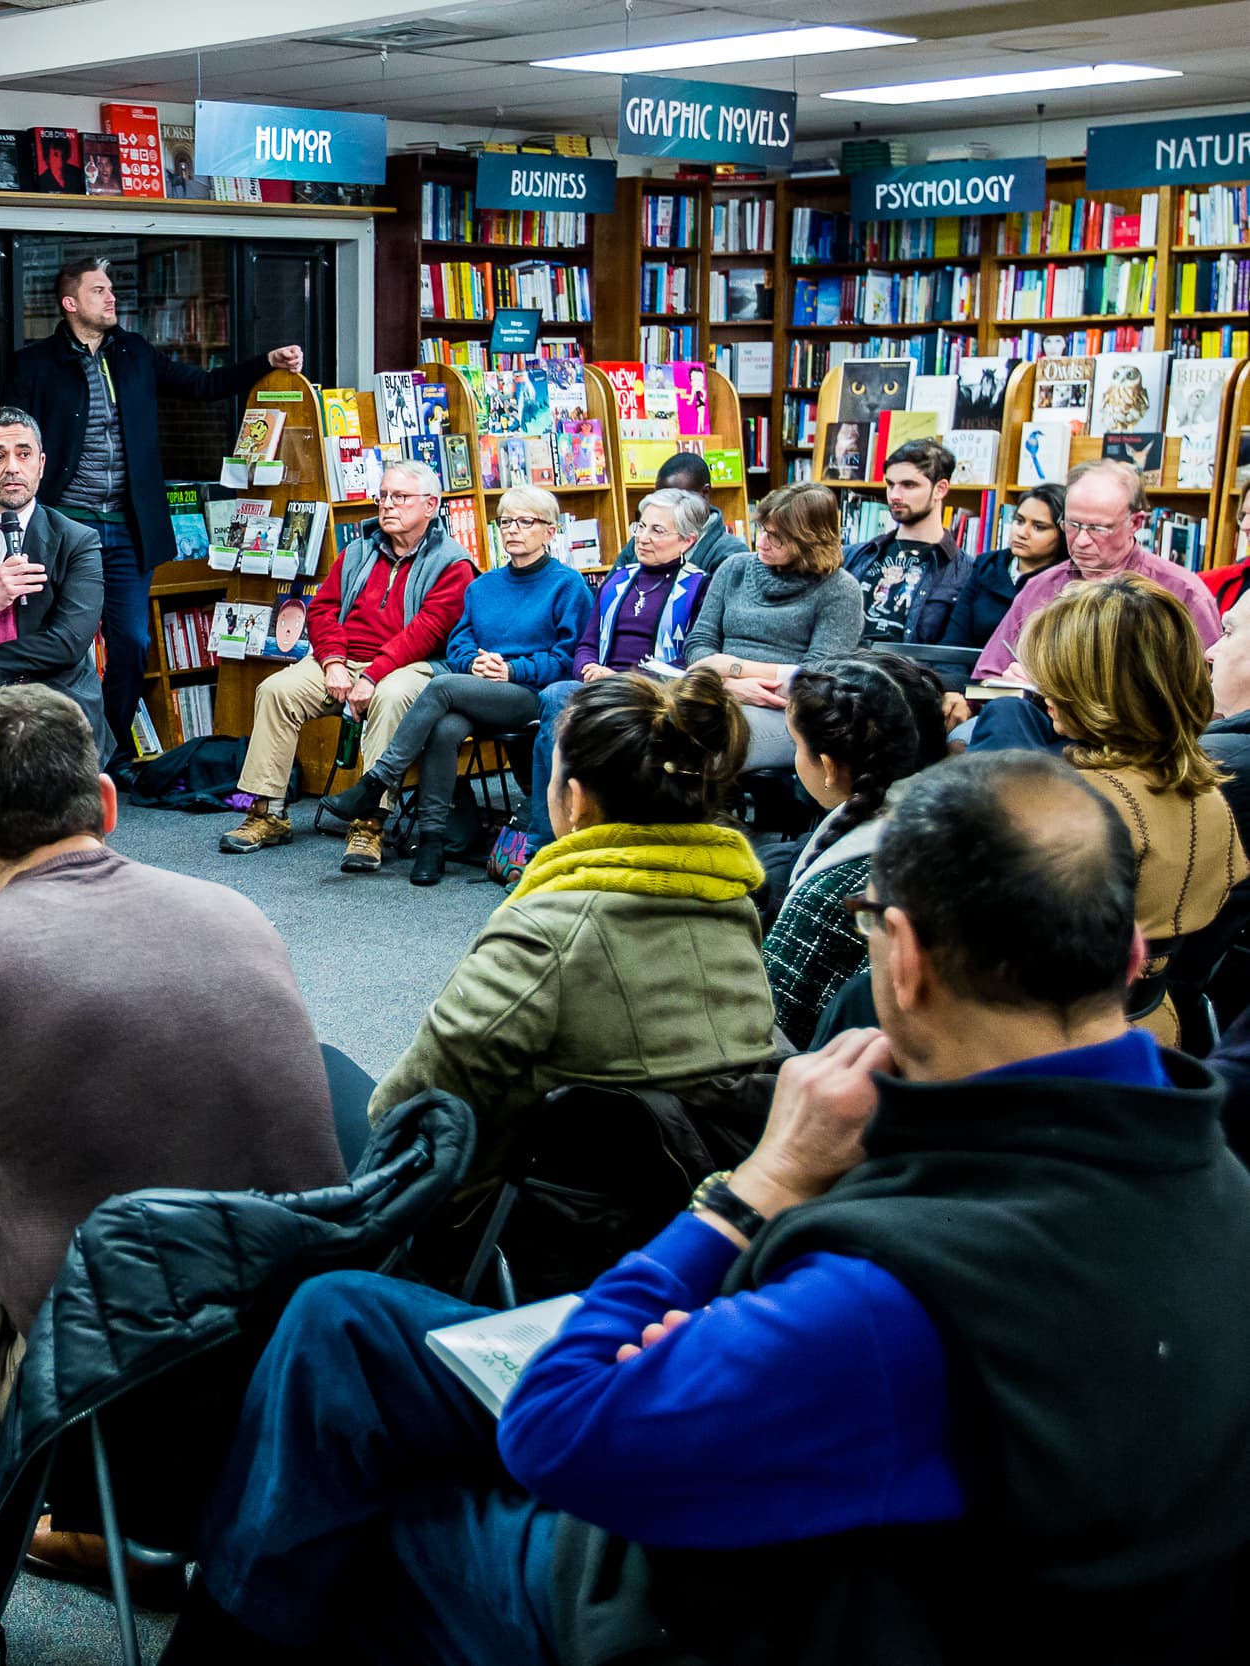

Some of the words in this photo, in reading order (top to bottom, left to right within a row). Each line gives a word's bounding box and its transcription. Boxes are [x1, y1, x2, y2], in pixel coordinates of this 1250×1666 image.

[41, 130, 53, 138] BOB
[53, 130, 76, 139] DYLAN
[625, 97, 712, 141] GRAPHIC
[716, 105, 791, 148] NOVELS
[255, 125, 332, 164] HUMOR
[510, 169, 587, 200] BUSINESS
[875, 174, 1015, 210] PSYCHOLOGY
[384, 375, 411, 390] BLAME!
[1044, 362, 1083, 381] Owls
[276, 582, 291, 595] LAST
